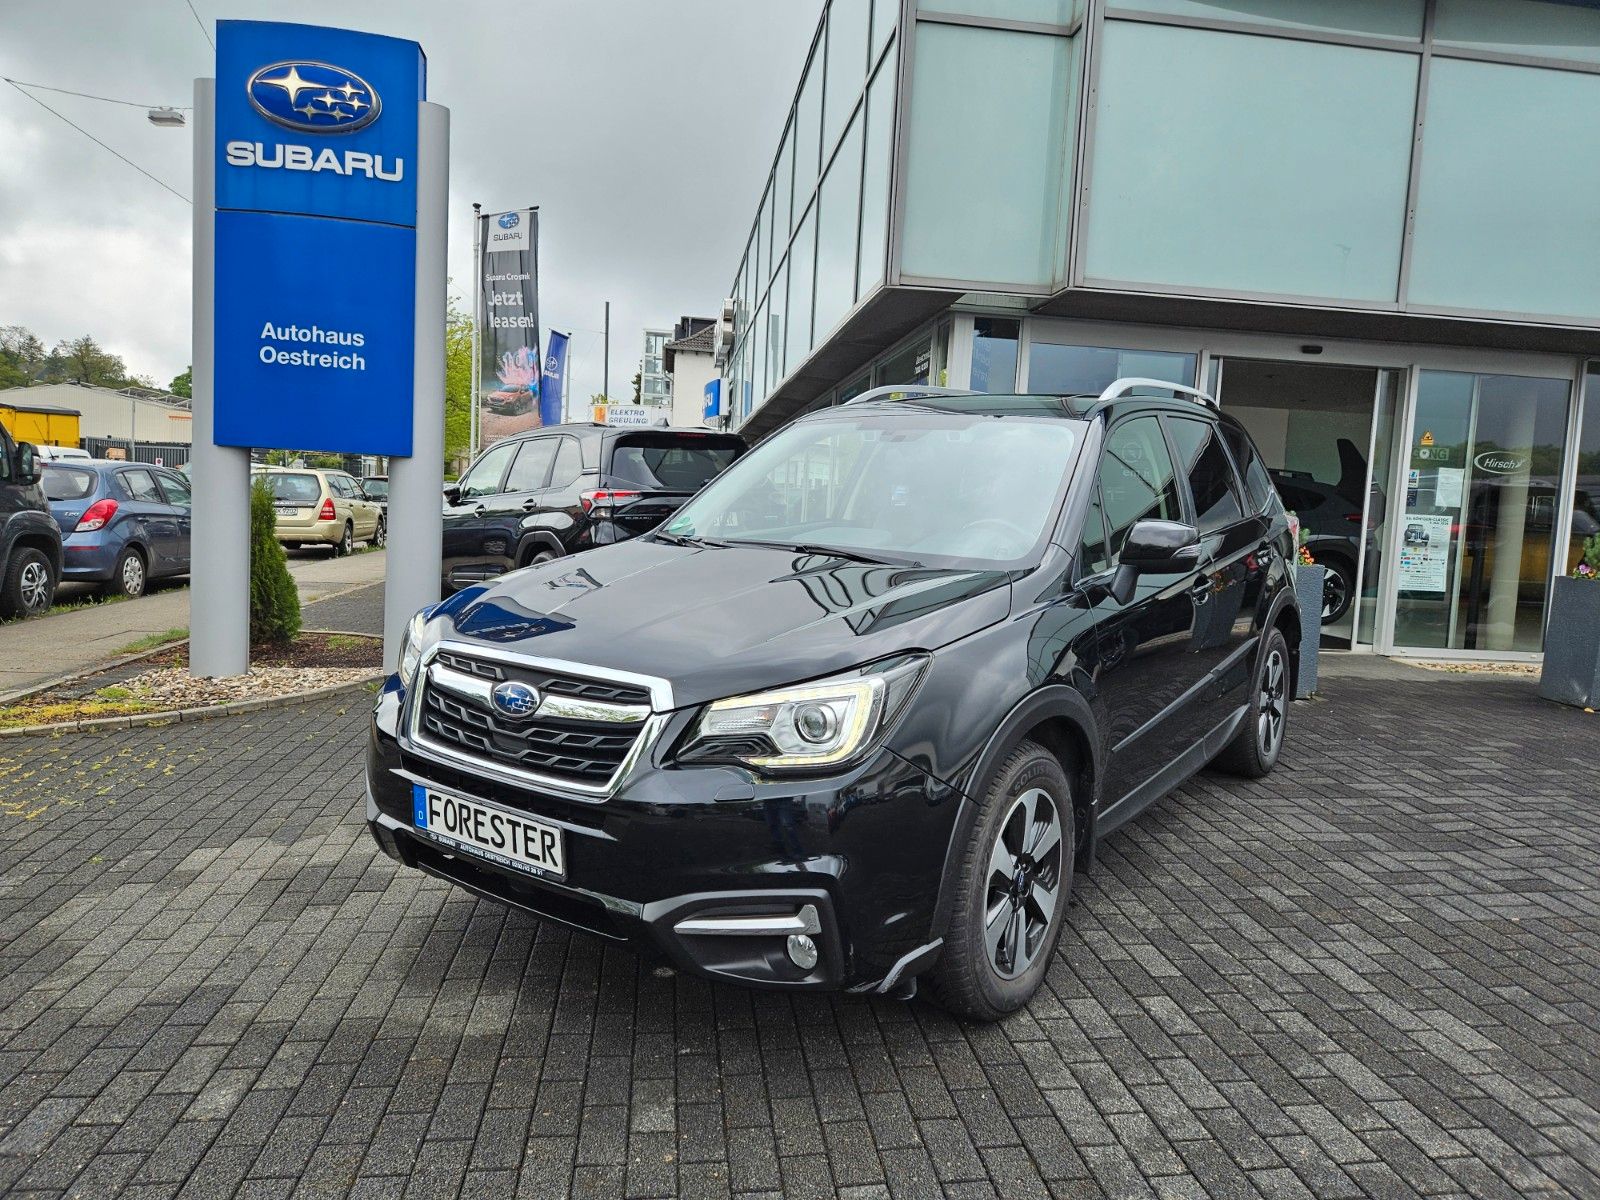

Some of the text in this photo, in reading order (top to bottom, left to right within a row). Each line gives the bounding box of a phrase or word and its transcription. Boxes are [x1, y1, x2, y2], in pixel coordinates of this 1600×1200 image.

[226, 141, 404, 182] SUBARU
[488, 290, 524, 307] Jetzt
[489, 311, 535, 328] leasen!
[260, 322, 365, 347] Autohaus
[259, 346, 366, 371] Oestreich
[1484, 458, 1516, 469] Hirsch
[418, 794, 559, 867] D FORESTER
